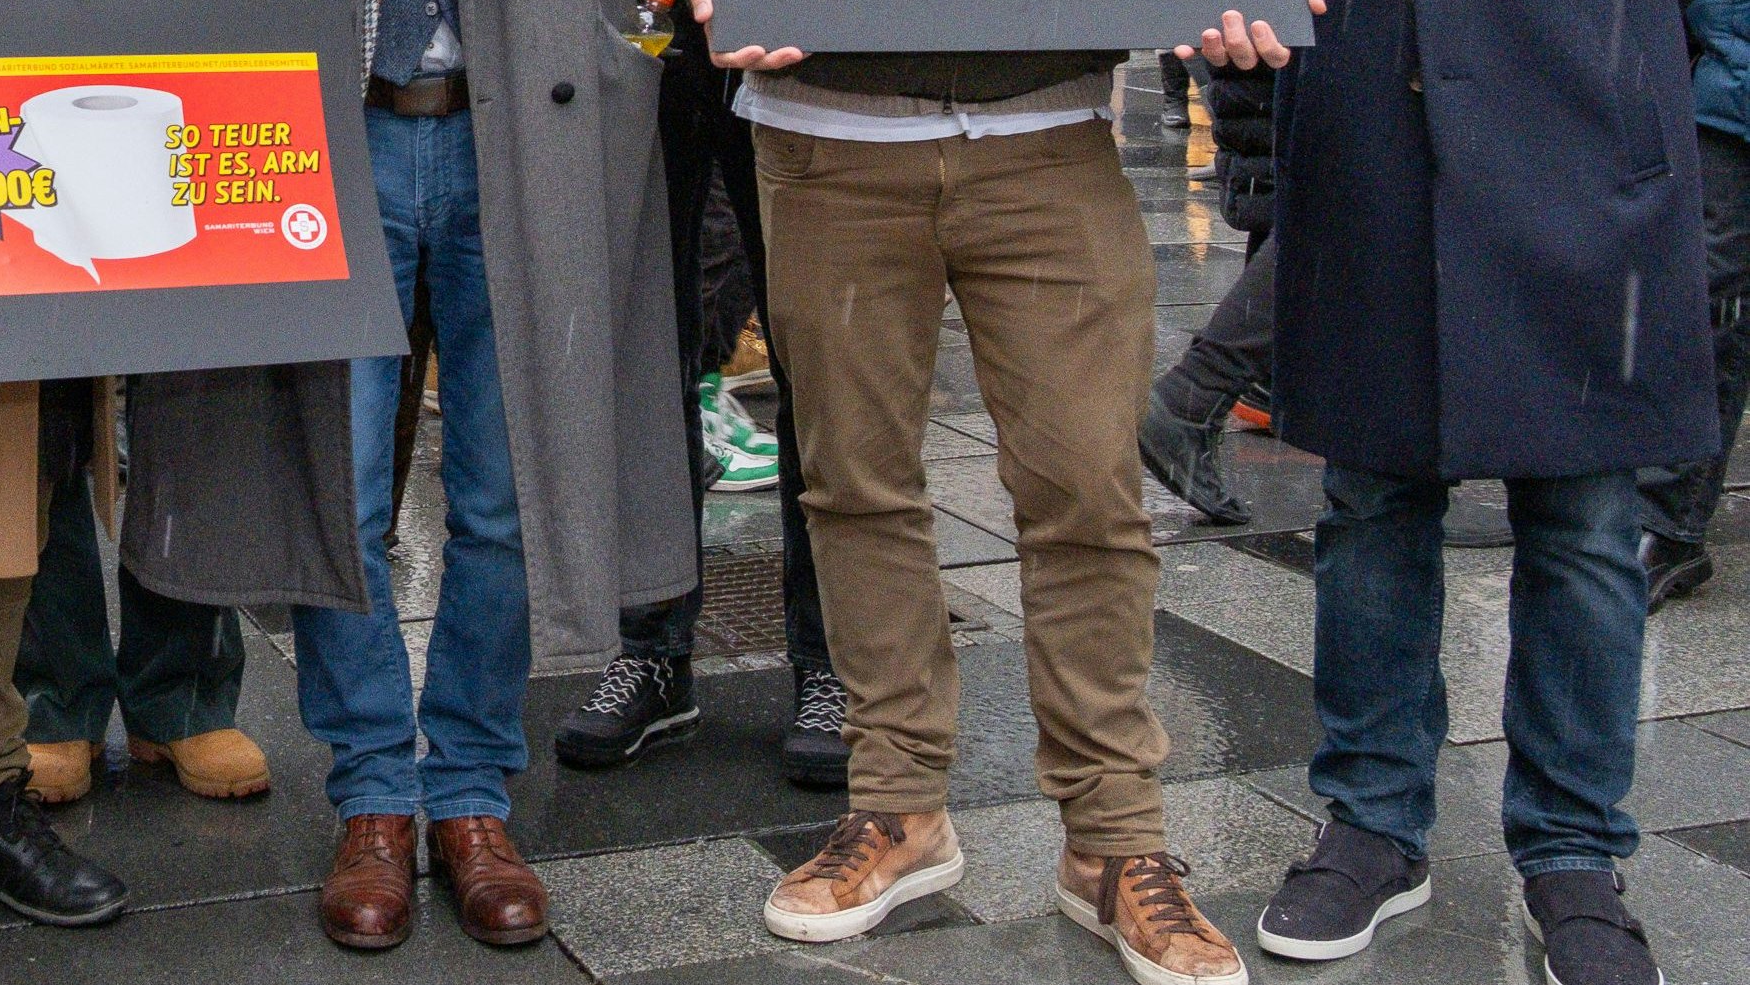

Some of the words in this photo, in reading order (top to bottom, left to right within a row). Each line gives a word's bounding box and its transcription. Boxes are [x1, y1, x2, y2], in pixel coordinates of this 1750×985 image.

[162, 124, 201, 149] SO
[207, 122, 292, 147] TEUER
[166, 153, 212, 177] IST
[215, 151, 256, 178] ES,
[260, 149, 321, 174] ARM
[169, 181, 207, 206] ZU
[212, 178, 281, 204] SEIN.
